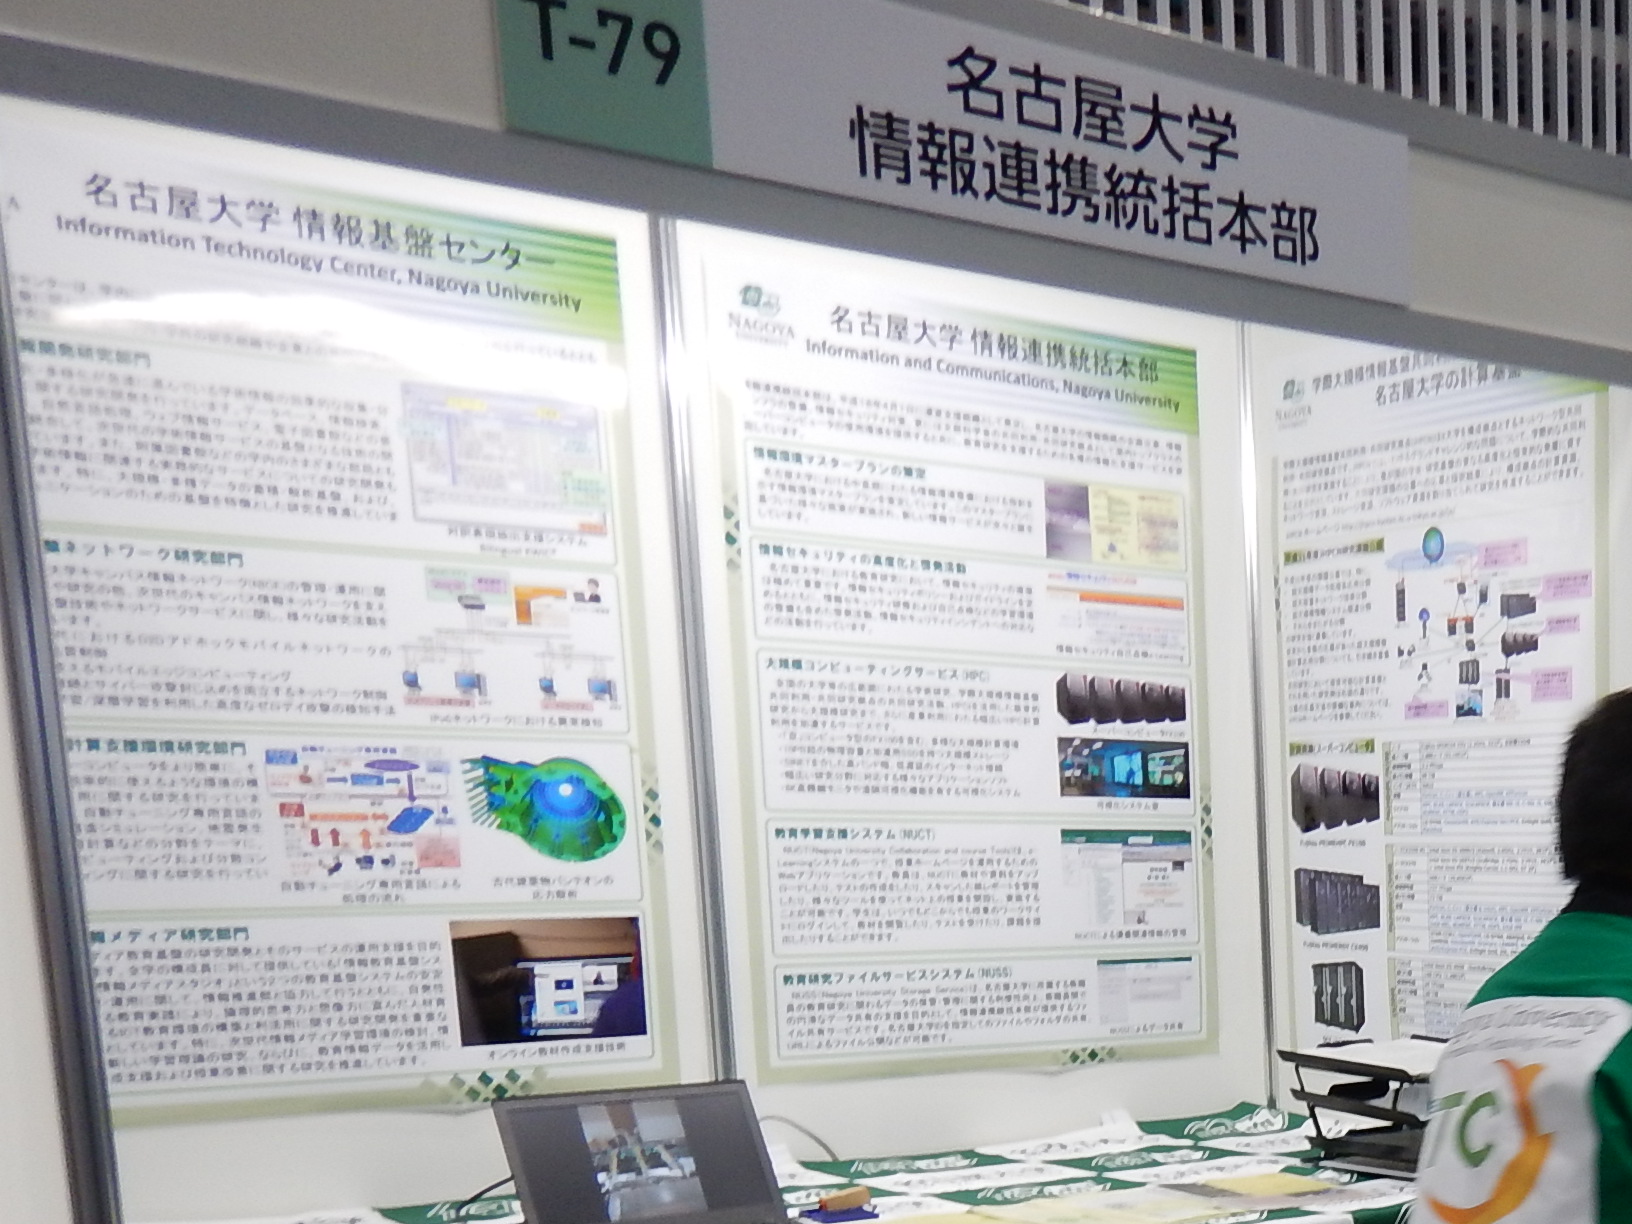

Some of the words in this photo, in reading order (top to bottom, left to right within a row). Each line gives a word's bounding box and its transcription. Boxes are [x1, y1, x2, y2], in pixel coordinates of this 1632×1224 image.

[525, 0, 682, 88] T-79
[946, 45, 1240, 173] 名古屋大学
[86, 173, 281, 233] 名古屋大学
[293, 205, 557, 270] 情報基盤センター
[849, 103, 1321, 267] 情報連携統括本部
[56, 214, 197, 252] Information
[202, 234, 323, 272] Technology
[330, 254, 402, 285] Center,
[408, 268, 482, 300] Nagoya
[487, 281, 581, 313] University
[805, 338, 900, 367] Information
[904, 355, 932, 371] and
[937, 357, 1059, 394] Communications,
[1063, 379, 1112, 403] Nagoya
[1115, 386, 1181, 413] University
[830, 304, 962, 351] 名古屋大学
[970, 327, 1159, 384] 情報連携統括本部
